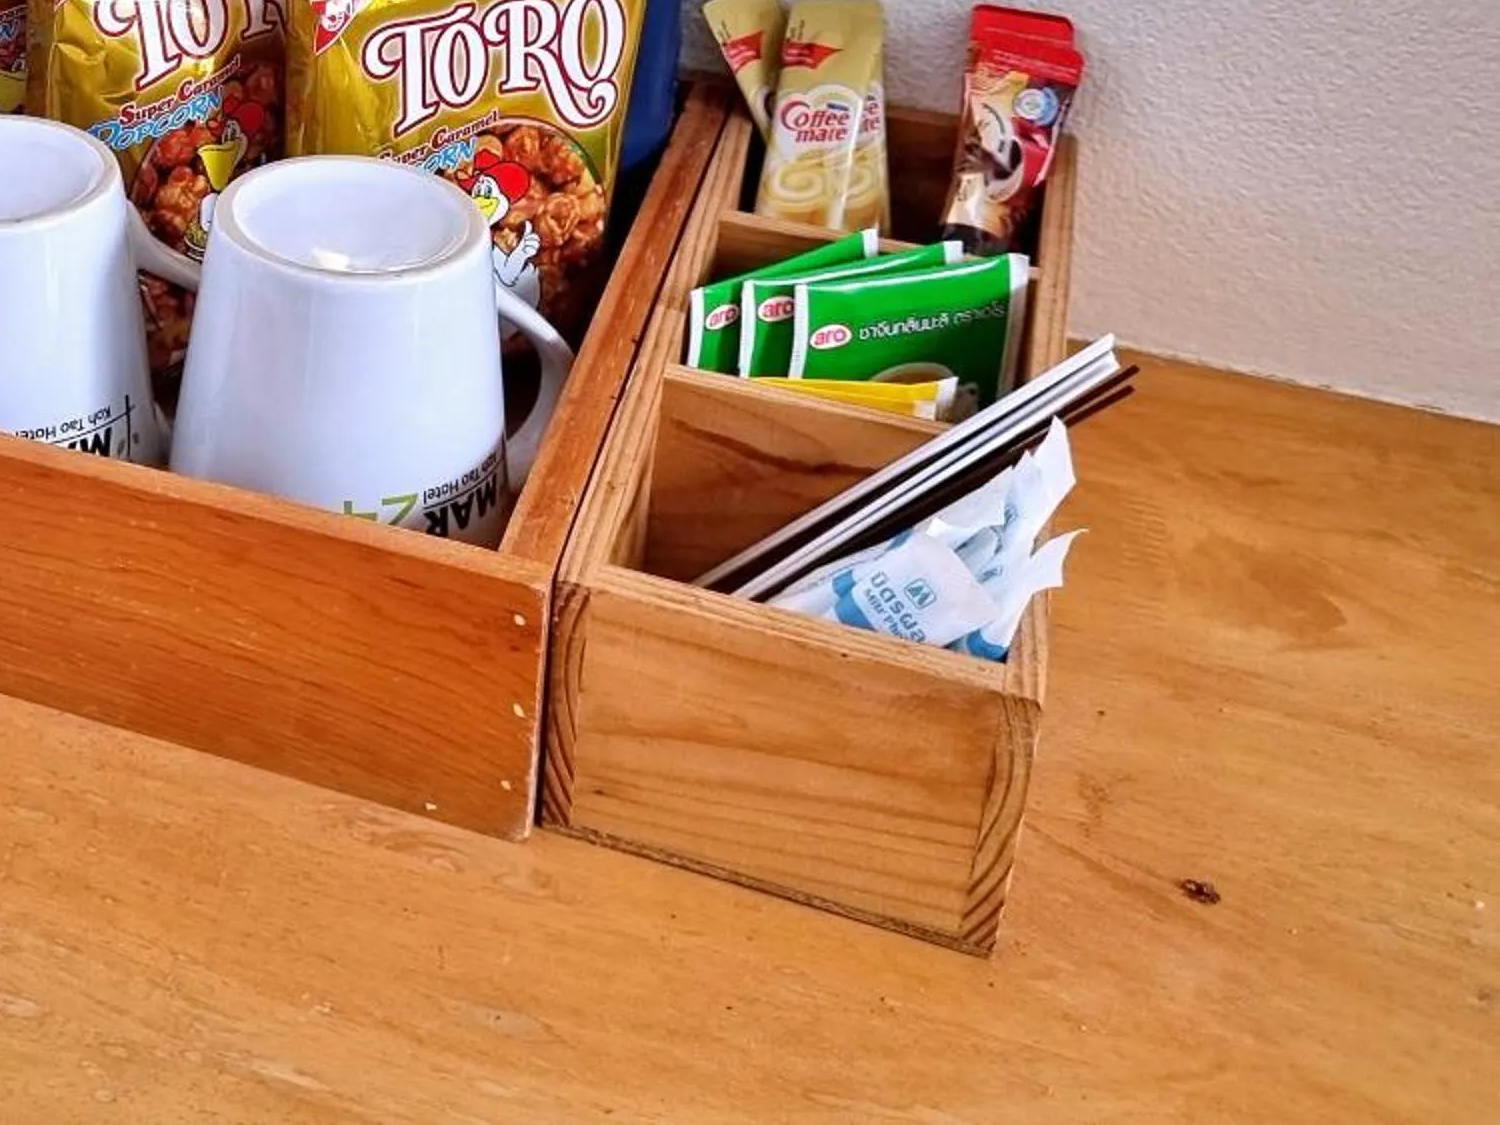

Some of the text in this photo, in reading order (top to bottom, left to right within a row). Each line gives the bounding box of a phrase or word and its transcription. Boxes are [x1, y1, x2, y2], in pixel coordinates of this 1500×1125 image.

[118, 96, 176, 126] Super
[779, 99, 850, 132] Coffee
[430, 107, 500, 152] Caramel
[794, 126, 849, 144] mate
[813, 328, 847, 346] aro
[87, 405, 112, 425] Koh
[59, 418, 84, 433] Tao
[461, 467, 481, 485] Tao
[423, 478, 459, 504] Hotel
